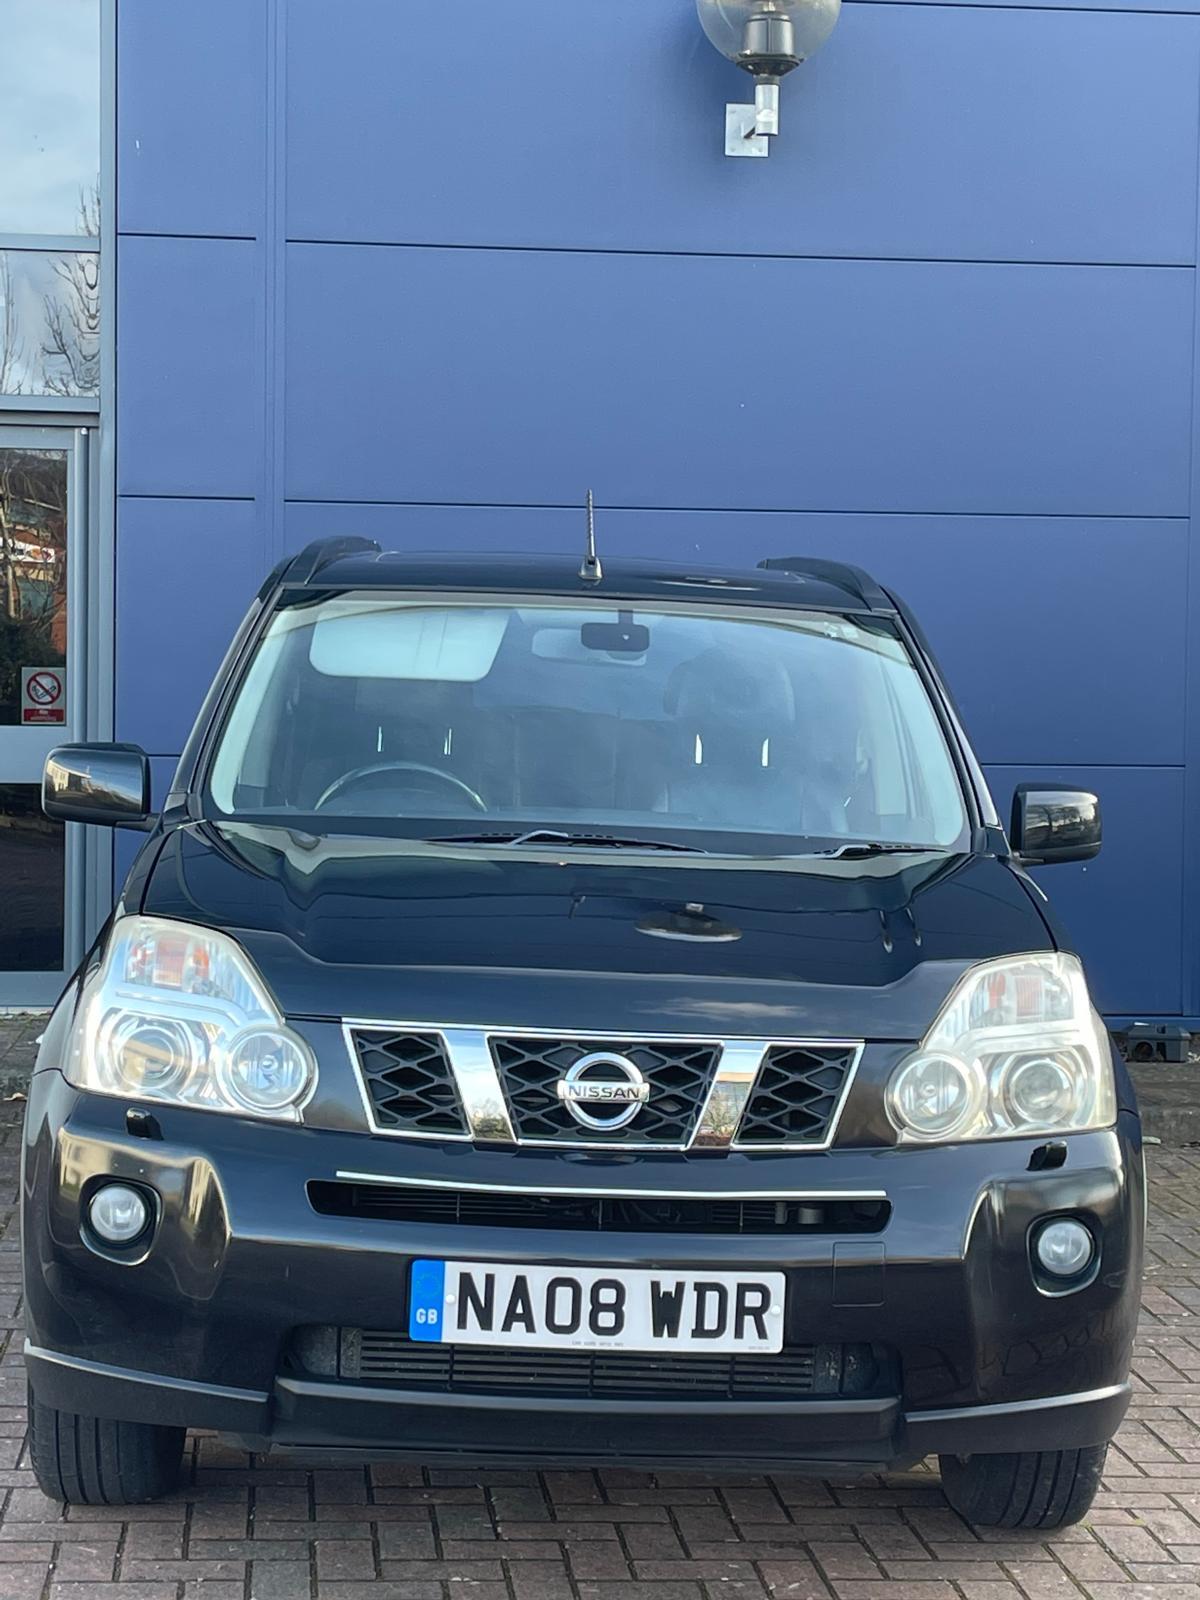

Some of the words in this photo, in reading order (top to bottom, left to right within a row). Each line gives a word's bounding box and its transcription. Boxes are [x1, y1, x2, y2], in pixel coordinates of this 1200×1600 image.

[568, 1085, 640, 1099] NISSAN
[457, 1272, 626, 1337] NA08
[650, 1280, 771, 1340] WDR
[416, 1307, 438, 1325] GB
